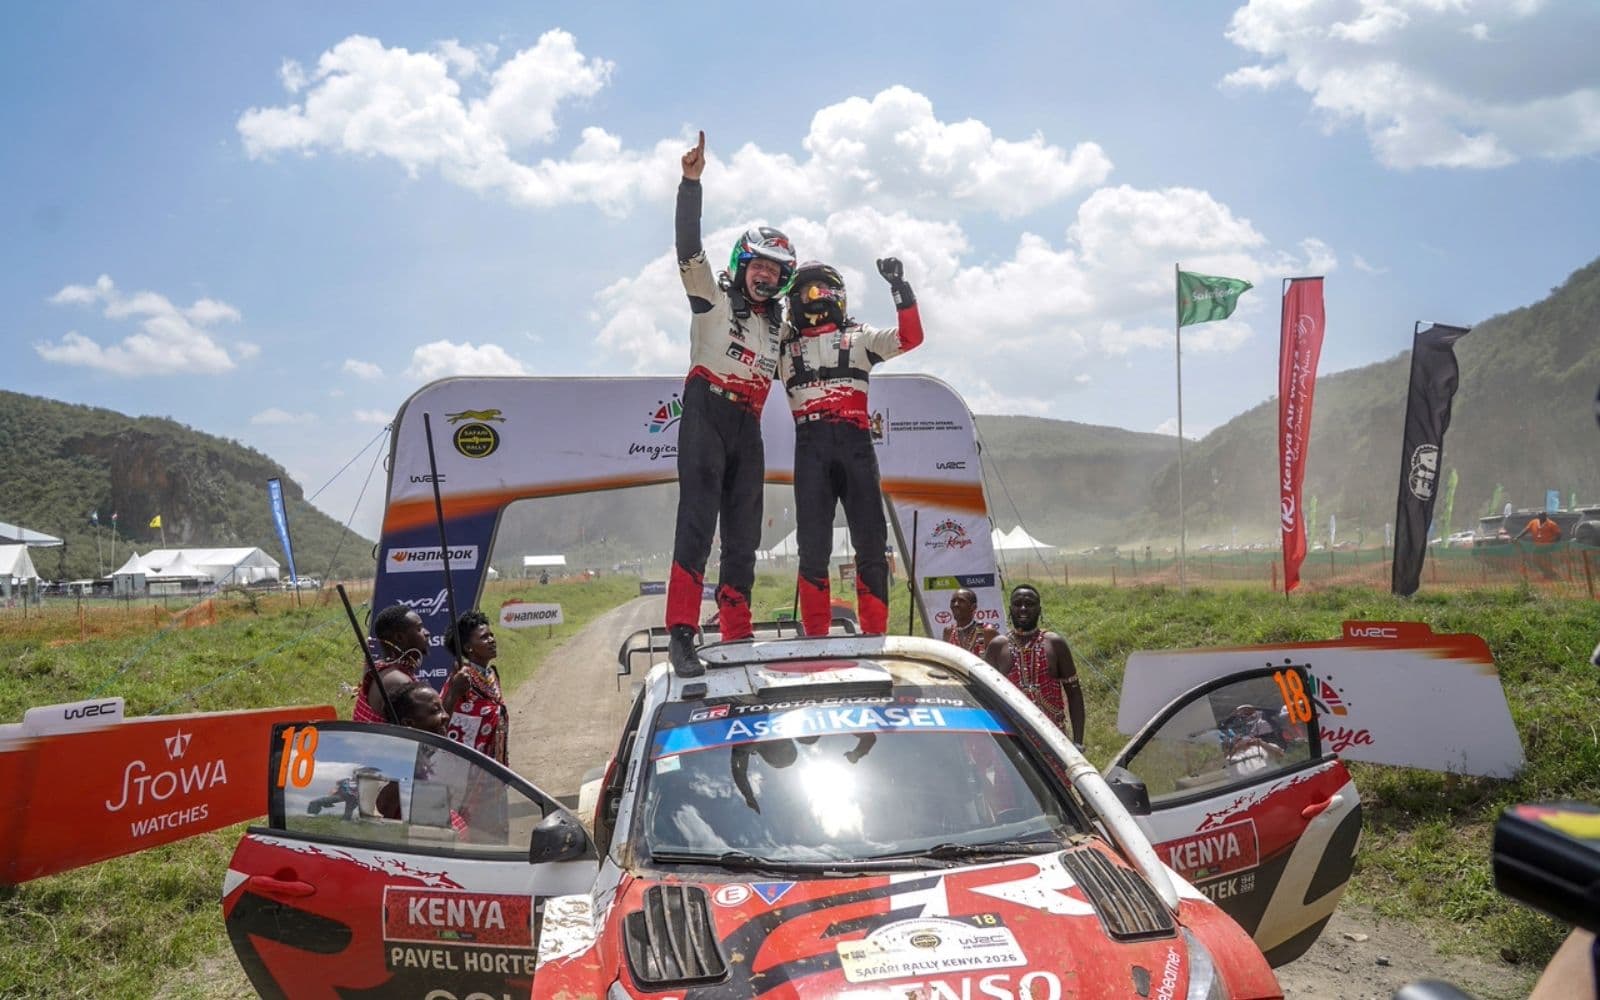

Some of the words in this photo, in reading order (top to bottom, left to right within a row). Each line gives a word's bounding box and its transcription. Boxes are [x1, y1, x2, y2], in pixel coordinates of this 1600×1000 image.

[728, 347, 754, 367] GR
[628, 443, 678, 461] Magica
[1283, 435, 1293, 491] Kenya
[936, 461, 966, 470] WRC
[410, 474, 446, 483] WRC
[974, 609, 1000, 620] OTA
[1350, 626, 1398, 638] WRC
[1272, 668, 1313, 725] 18
[64, 702, 116, 720] WRC
[689, 703, 731, 722] GR
[735, 698, 817, 713] TOYOTA
[821, 696, 895, 705] GAZOO
[897, 696, 964, 706] Racing
[1319, 725, 1375, 753] nya
[277, 726, 320, 789] 18
[105, 758, 228, 812] STOWA
[131, 804, 209, 837] WATCHES
[1169, 832, 1241, 872] KENYA
[1200, 878, 1238, 900] RTEK
[408, 897, 506, 930] KENYA
[971, 913, 998, 926] 18
[958, 935, 1008, 946] WRC
[391, 947, 459, 971] PAVEL
[464, 951, 537, 975] HORTE
[855, 964, 901, 977] SAFARI
[903, 960, 939, 971] RALLY
[942, 956, 983, 967] KENYA
[984, 953, 1018, 964] 2026
[1156, 946, 1181, 1000] ebeamer
